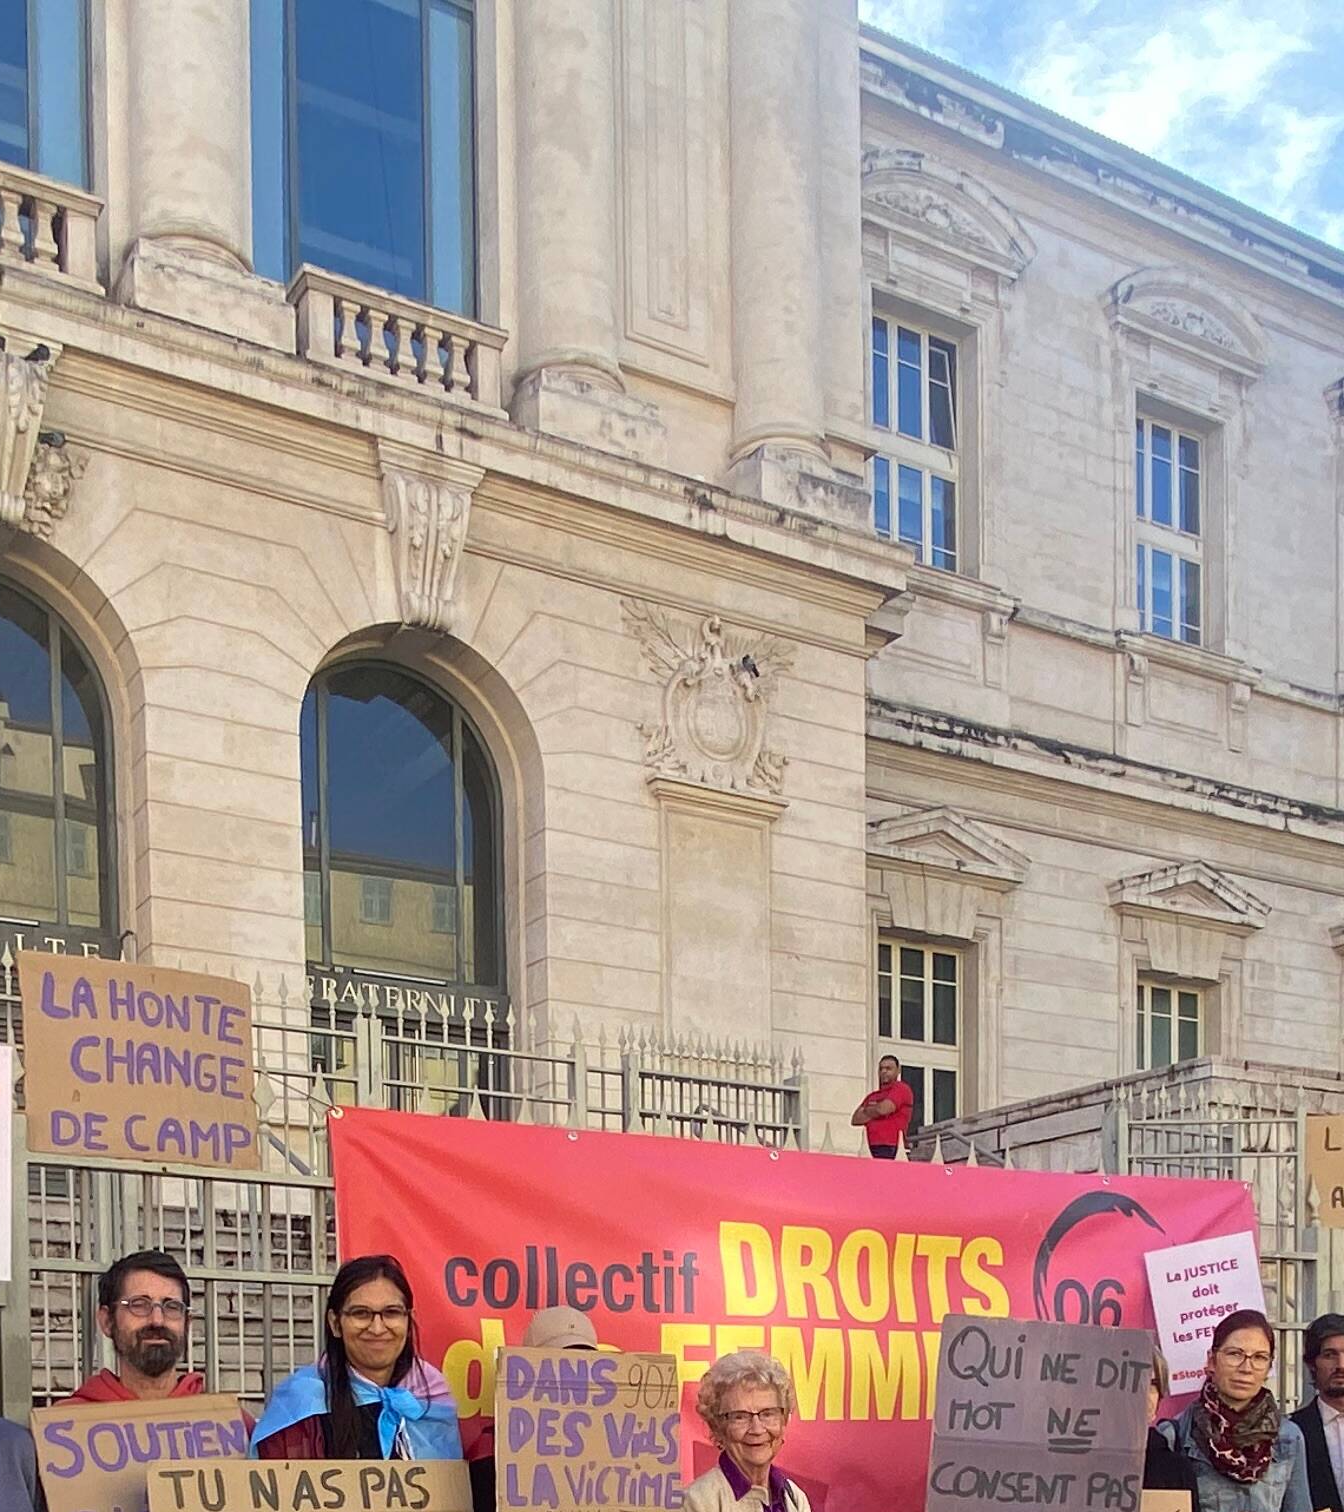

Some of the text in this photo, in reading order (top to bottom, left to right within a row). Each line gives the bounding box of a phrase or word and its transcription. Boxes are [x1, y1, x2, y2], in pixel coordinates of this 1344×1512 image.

[41, 971, 246, 1045] LA HONTE
[70, 1036, 245, 1099] CHANGE
[51, 1110, 251, 1163] DE CAMP
[445, 1221, 1126, 1328] collectif DROITS 06
[1184, 1259, 1239, 1281] JUSTICE
[1192, 1284, 1220, 1298] doit
[1180, 1302, 1239, 1324] protéger
[506, 1355, 677, 1410] DANS 90%
[948, 1326, 1151, 1393] QUI NE DIT
[159, 1462, 431, 1512] TU N'AS PAS
[506, 1461, 686, 1510] LA VICTIME
